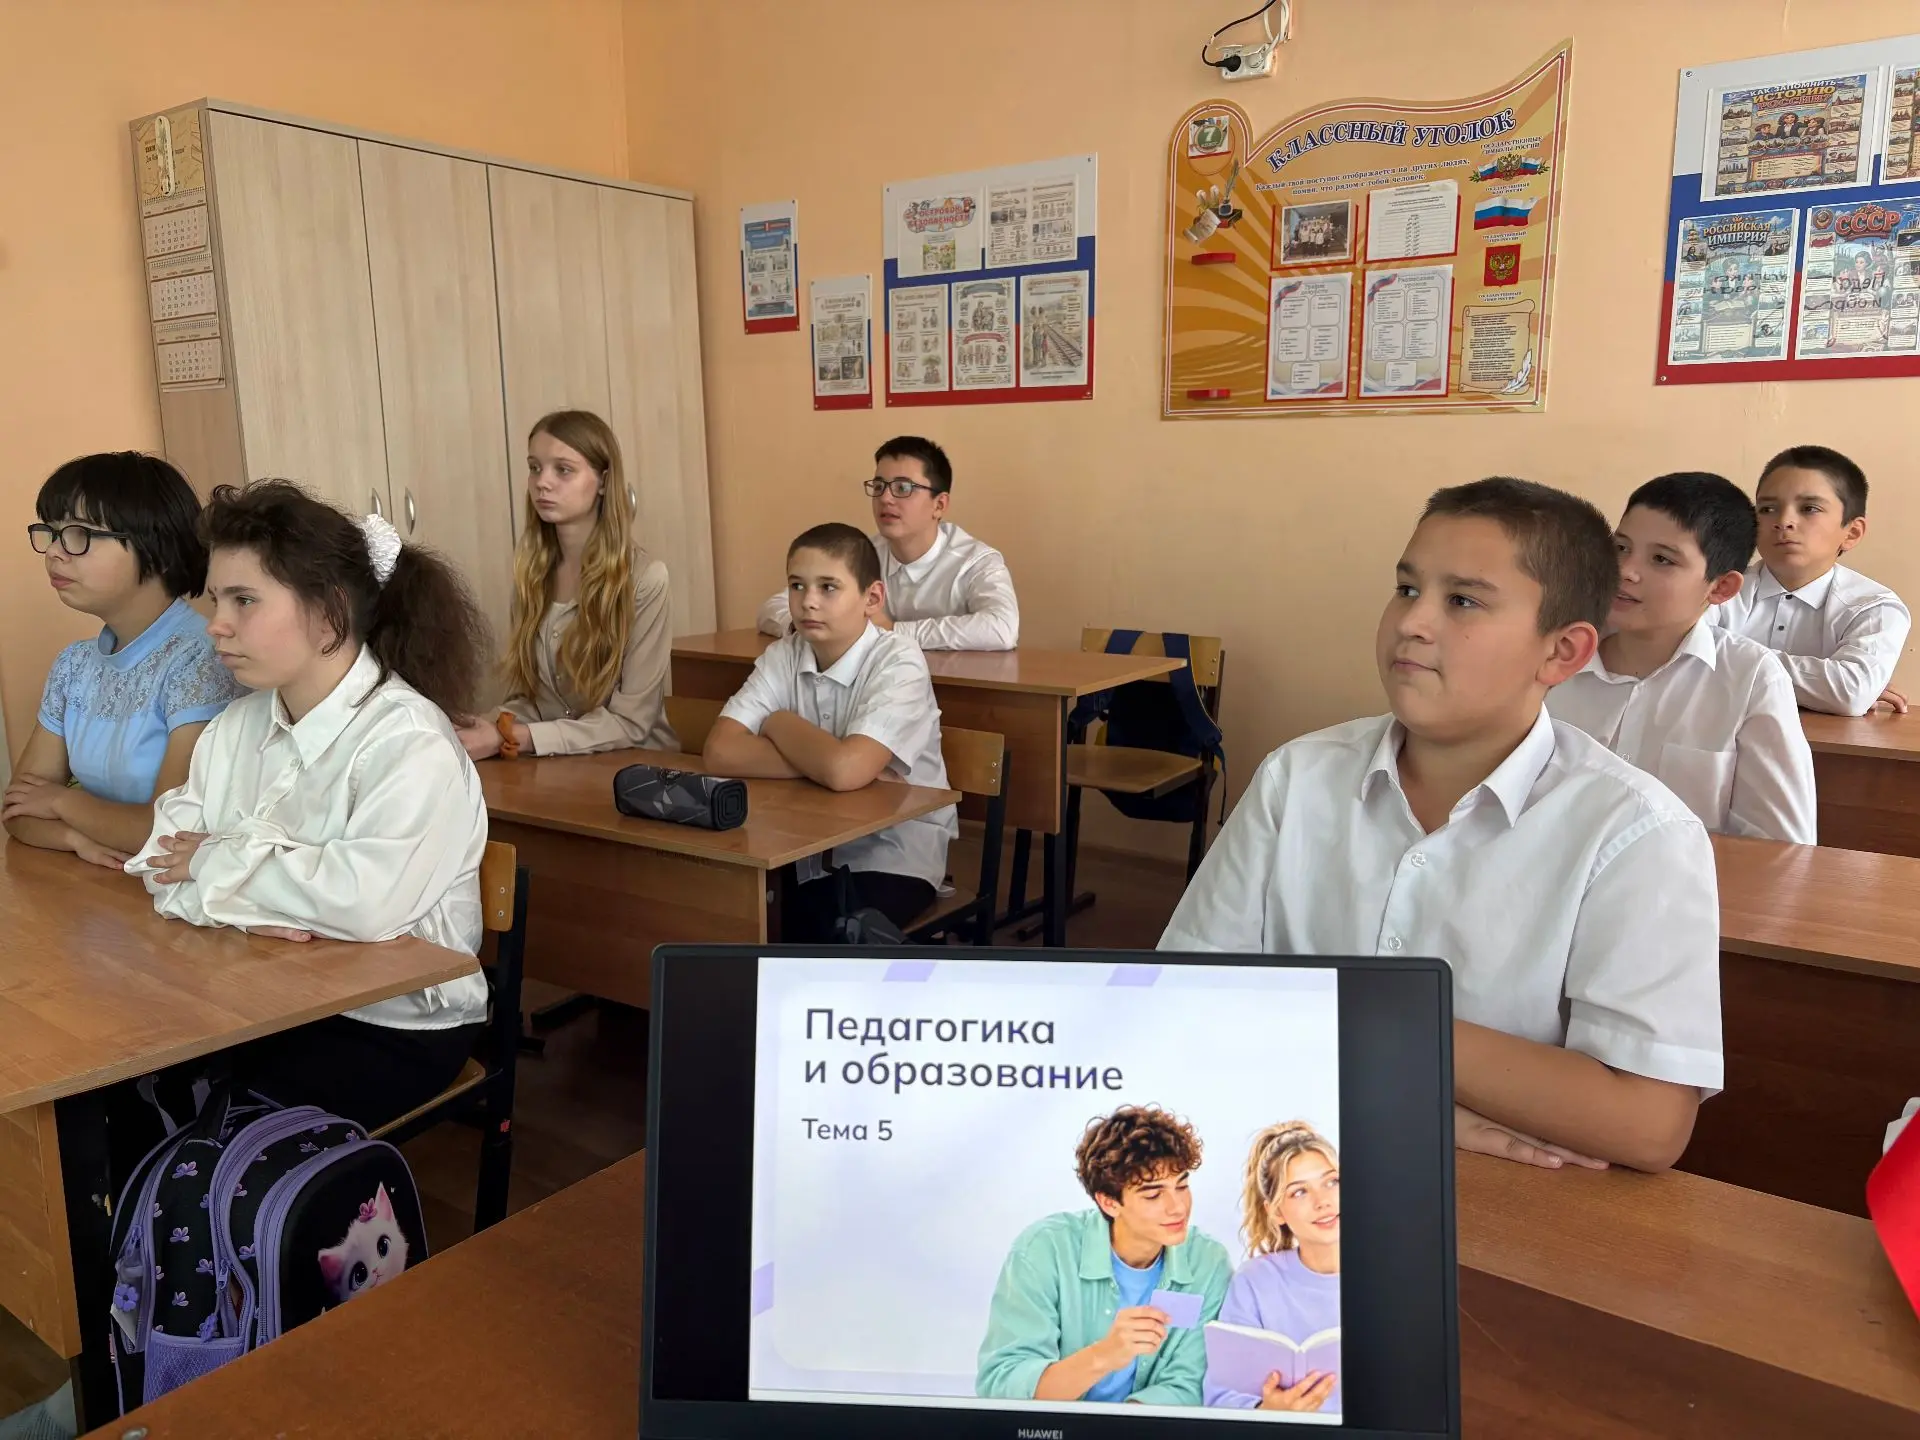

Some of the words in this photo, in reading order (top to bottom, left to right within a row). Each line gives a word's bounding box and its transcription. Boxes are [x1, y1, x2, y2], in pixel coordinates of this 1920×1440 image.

[1750, 88, 1770, 97] КАК
[1774, 80, 1836, 92] ЗАПОМНИТЬ
[1753, 86, 1836, 103] ИСТОРИЮ
[1203, 127, 1217, 141] 7
[1266, 121, 1407, 172] КЛАССНЫЙ
[1412, 108, 1516, 147] УГОЛОК
[1306, 175, 1340, 186] поступок
[1342, 168, 1396, 180] отображается
[1335, 182, 1359, 191] рядом
[1365, 177, 1389, 186] тобой
[1703, 222, 1771, 236] РОССИЙСКАЯ
[1834, 211, 1901, 236] СССР
[1708, 231, 1769, 246] ИМПЕРИЯ
[805, 1008, 1055, 1046] Педагогика
[804, 1060, 827, 1083] и
[842, 1052, 1124, 1094] образование
[801, 1118, 869, 1140] Тема
[877, 1119, 893, 1141] 5
[1018, 1429, 1063, 1439] HUAWEI
